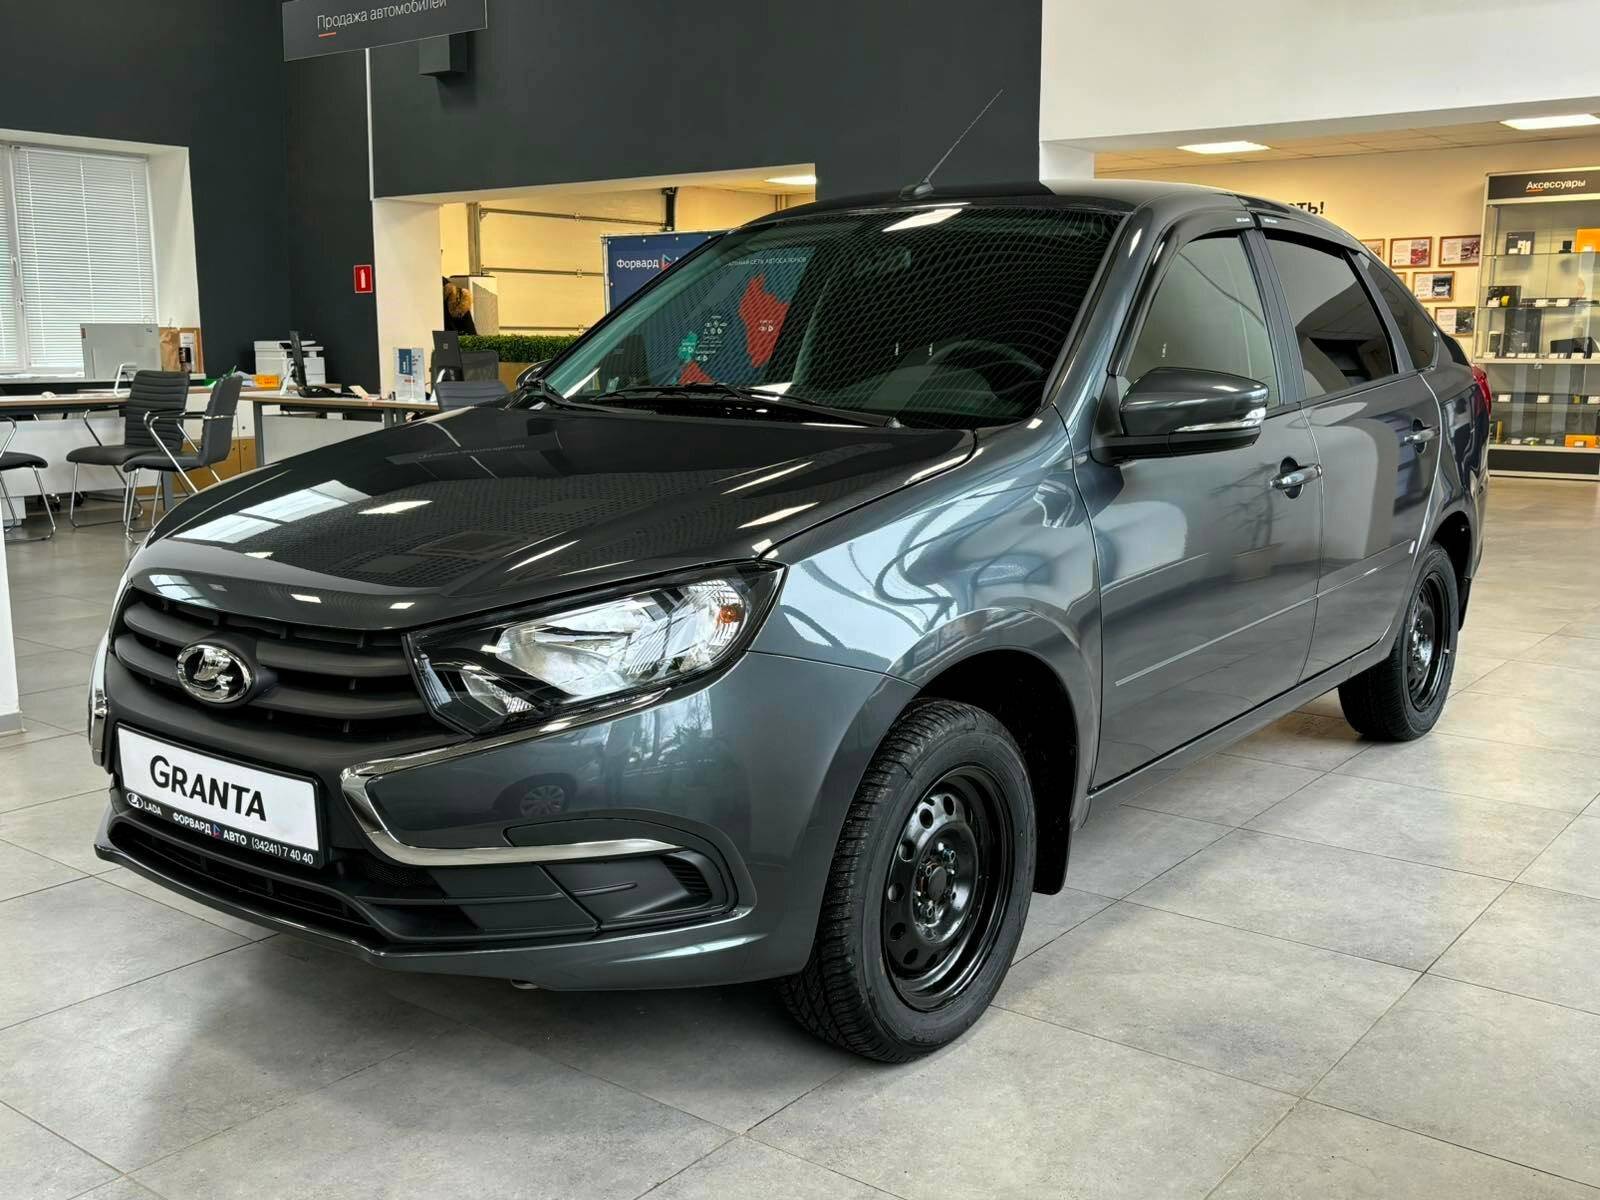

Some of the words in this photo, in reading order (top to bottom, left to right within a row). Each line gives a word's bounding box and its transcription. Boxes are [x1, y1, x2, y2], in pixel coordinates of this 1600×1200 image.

[317, 10, 368, 31] Продажа
[1526, 179, 1586, 190] Аксессуары
[616, 258, 660, 271] Форвард
[150, 755, 267, 822] GRANTA
[144, 801, 162, 816] LADA
[172, 812, 212, 836] ФОРВАРД
[223, 830, 247, 845] АВТО
[251, 837, 282, 857] (34241)
[282, 846, 289, 857] 7
[290, 849, 301, 861] 40
[302, 853, 314, 865] 40
